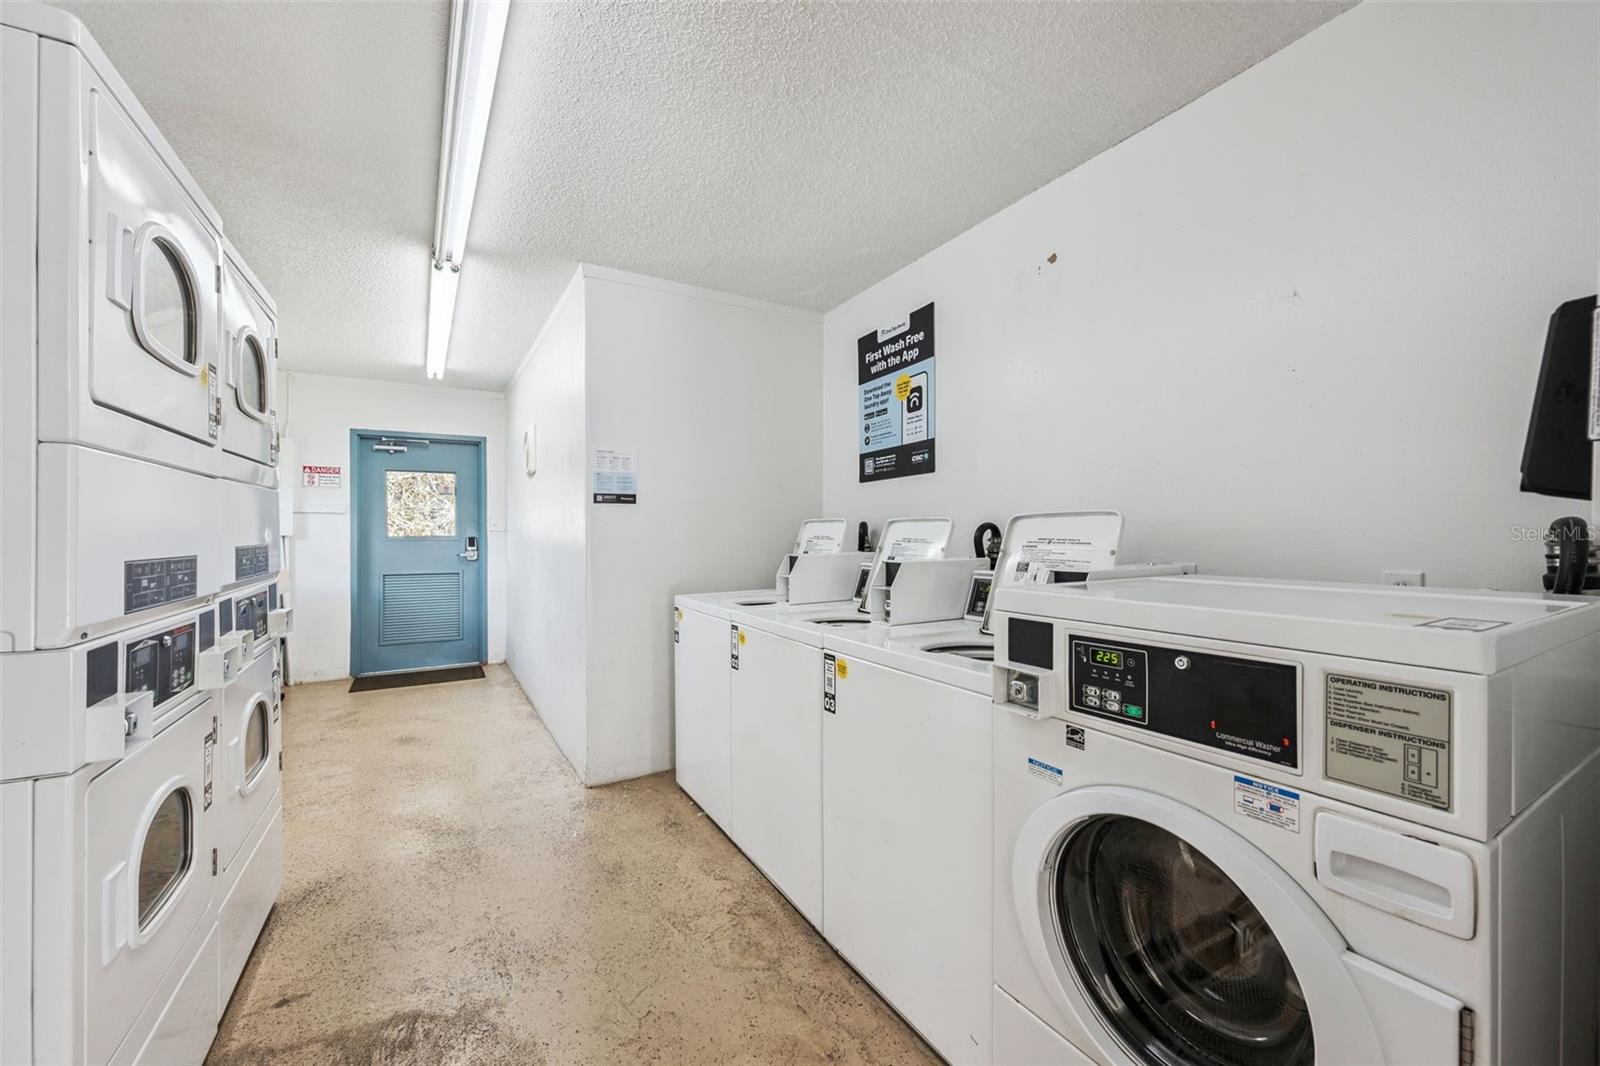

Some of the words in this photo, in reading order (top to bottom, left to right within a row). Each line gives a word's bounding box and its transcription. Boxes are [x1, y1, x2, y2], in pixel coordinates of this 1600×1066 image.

[866, 349, 882, 364] First
[882, 339, 904, 356] Wash
[906, 332, 924, 346] Free
[870, 360, 887, 374] with
[888, 356, 900, 367] the
[902, 348, 919, 362] App
[864, 384, 883, 396] Download
[864, 402, 879, 410] laundry
[912, 454, 923, 462] CSC
[1096, 651, 1118, 664] 225
[1330, 676, 1377, 690] OPERATING
[1379, 682, 1447, 701] INSTRUCTIONS
[825, 697, 834, 710] 03
[1330, 720, 1376, 735] DISPENSER
[1378, 731, 1446, 749] INSTRUCTIONS
[1216, 732, 1254, 746] Commercial
[1255, 741, 1281, 752] Washer
[1252, 781, 1279, 793] NOTICE
